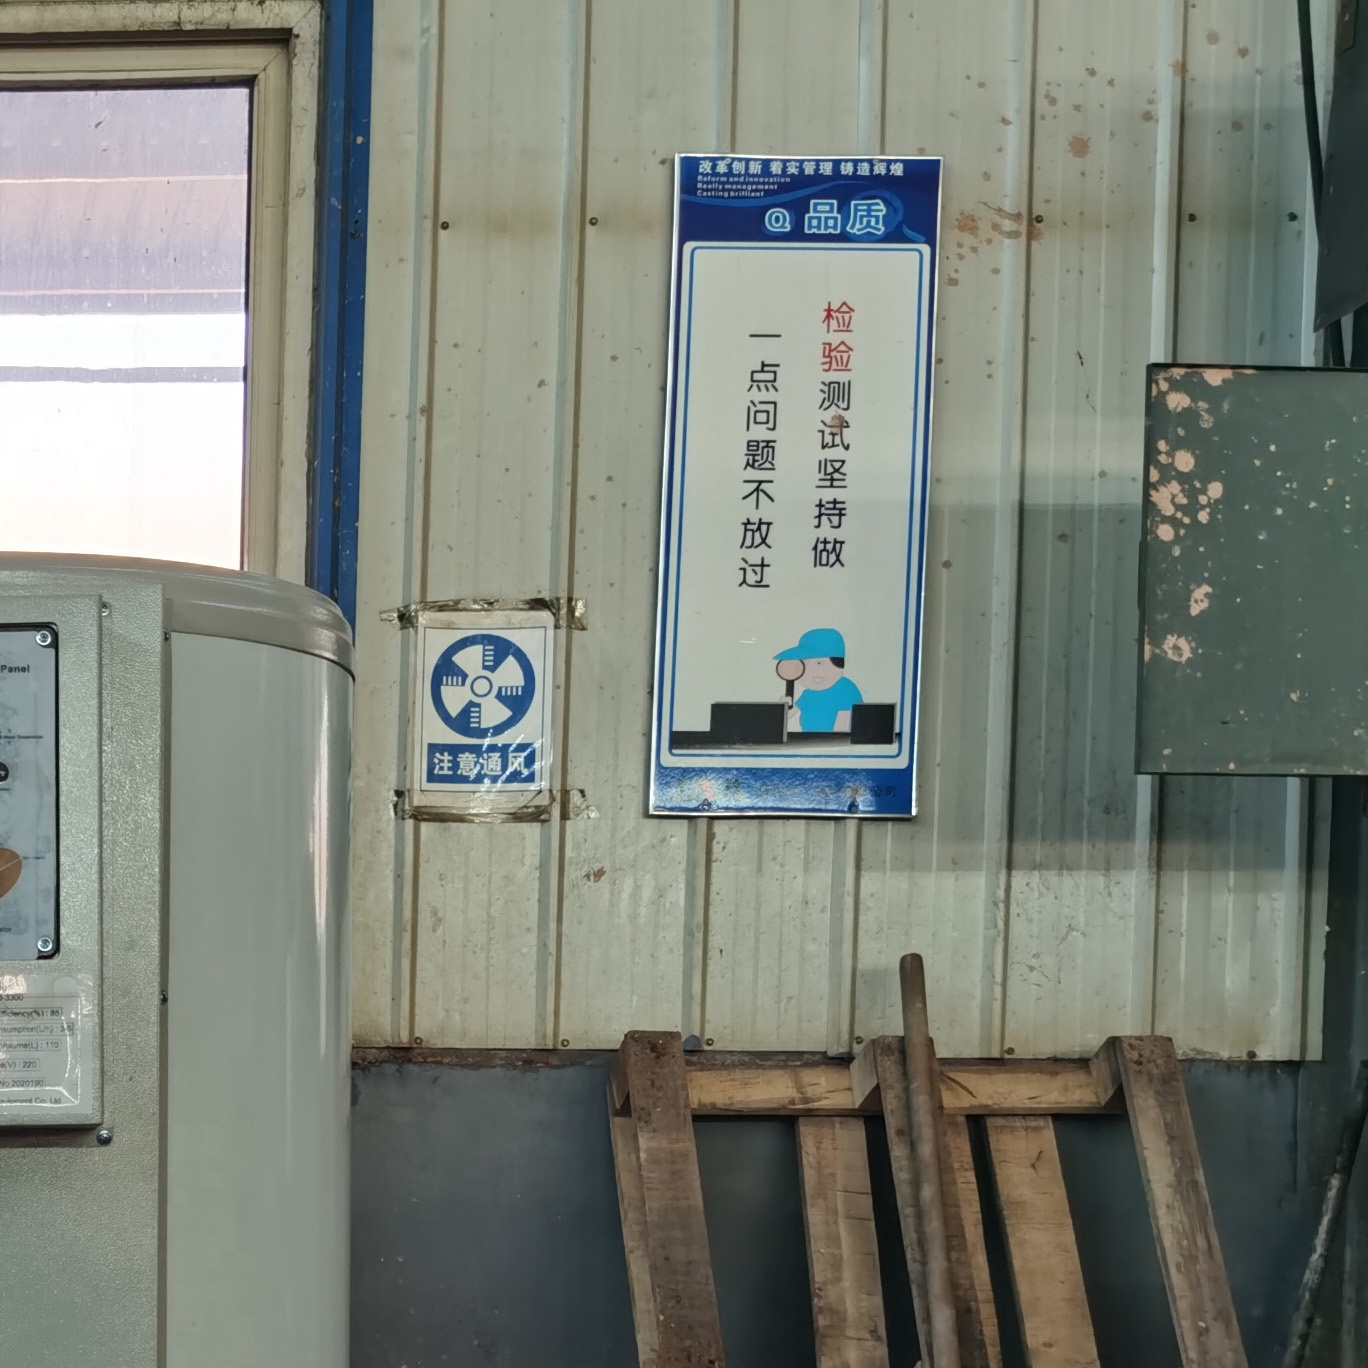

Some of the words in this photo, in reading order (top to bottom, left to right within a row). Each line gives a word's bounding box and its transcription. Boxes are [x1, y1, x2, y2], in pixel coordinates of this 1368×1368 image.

[699, 160, 762, 174] 改革创新
[805, 199, 886, 234] 品质
[812, 301, 855, 568] 检验测试坚持做
[738, 333, 782, 588] 一点问题不放过
[0, 664, 30, 673] Panel
[433, 752, 528, 776] 注意通风
